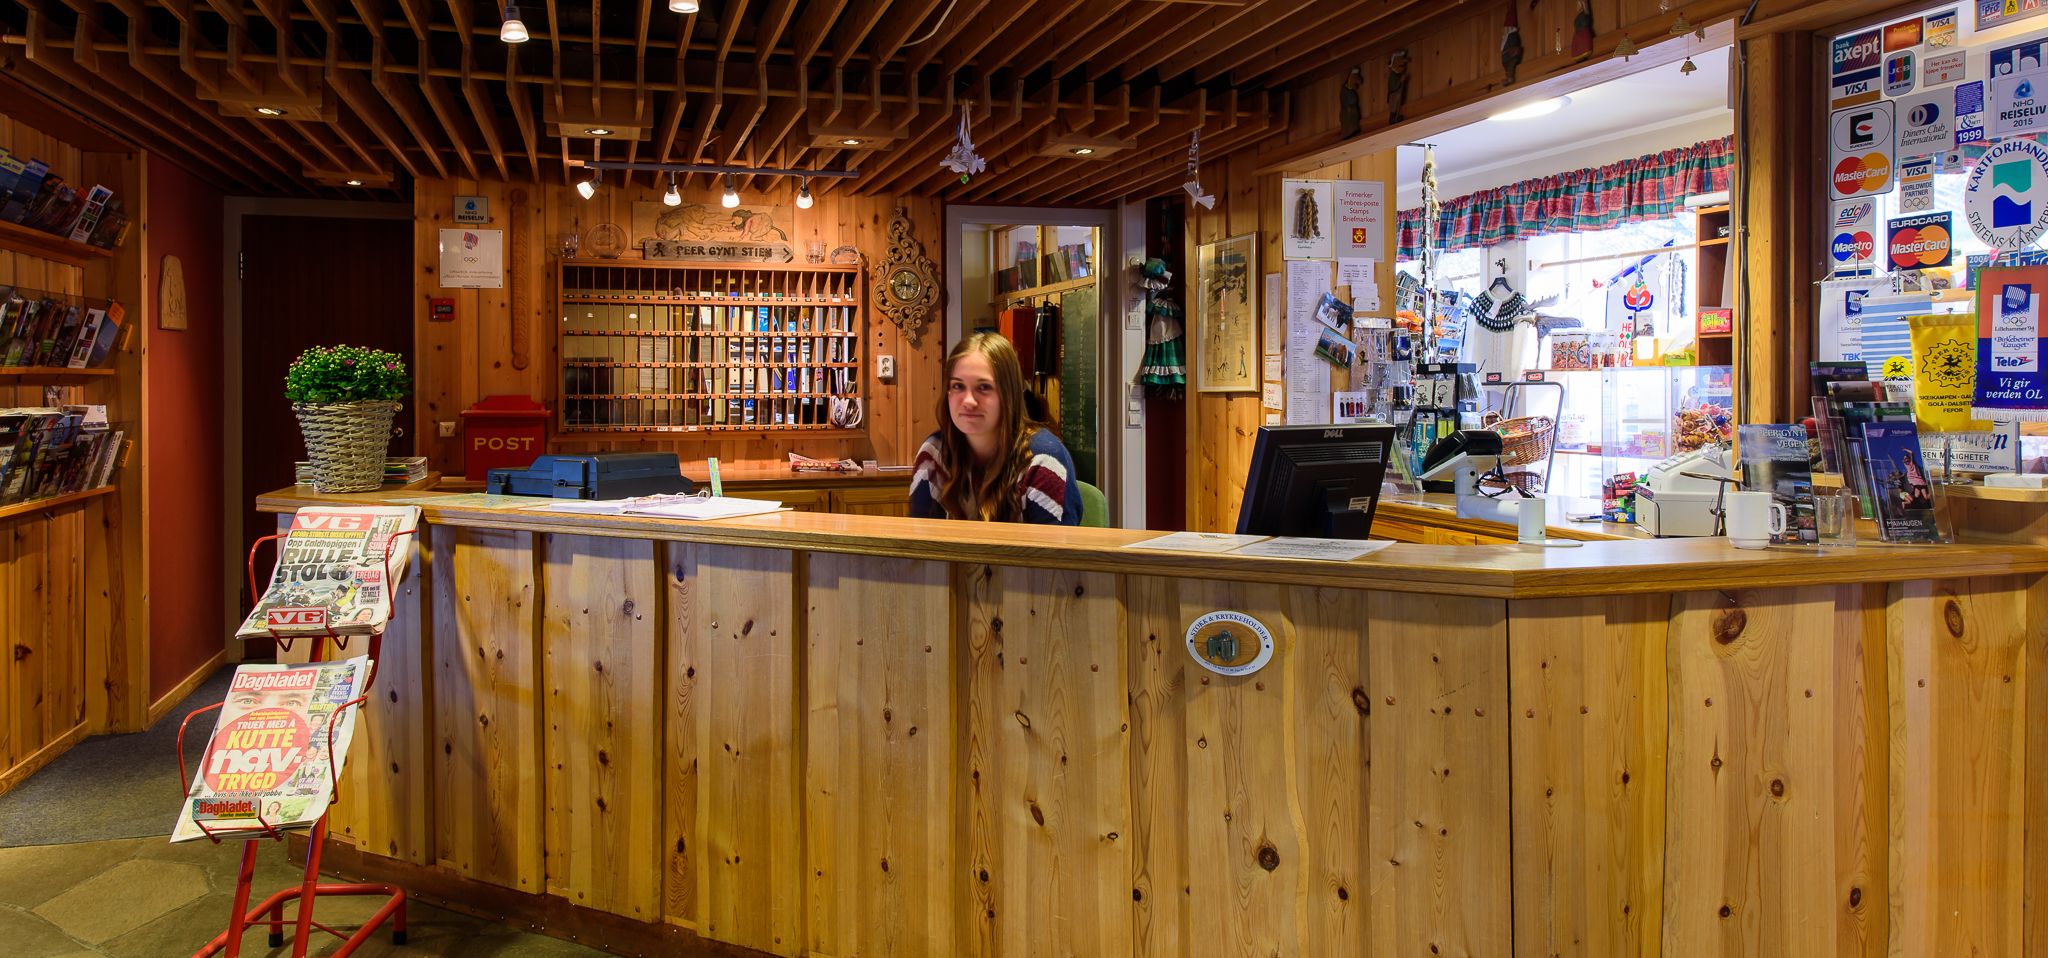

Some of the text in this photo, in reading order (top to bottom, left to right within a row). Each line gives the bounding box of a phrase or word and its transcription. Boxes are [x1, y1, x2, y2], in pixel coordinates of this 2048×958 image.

[1932, 18, 1950, 28] VISA
[1834, 33, 1880, 63] axept
[1835, 40, 1850, 50] bank
[1844, 82, 1868, 95] VISA
[2013, 99, 2034, 108] NHO
[2000, 105, 2047, 120] REISELIV
[2013, 118, 2033, 127] 2015
[1902, 123, 1946, 138] Diners Club
[1957, 130, 1982, 142] 1999
[1900, 132, 1948, 147] International
[1834, 166, 1889, 183] MasterCard
[1906, 166, 1928, 176] VISA
[1901, 182, 1933, 191] WORLDWIDE
[1340, 199, 1379, 207] Timbres-poste
[1890, 215, 1949, 228] EUROCARD
[1969, 211, 2005, 248] STATENS
[676, 246, 773, 257] PEER GYNT STIEN
[1833, 241, 1873, 253] Maestro
[1890, 238, 1949, 255] MasterCard
[1842, 353, 1861, 361] TBK
[1999, 377, 2031, 390] Vi gir
[1986, 389, 2043, 400] verden OL
[1323, 429, 1344, 439] DELL
[1780, 429, 1804, 437] GYNT
[474, 437, 535, 451] POST
[1776, 440, 1807, 448] VEGEN
[297, 515, 362, 530] VG
[287, 539, 303, 547] Opp
[282, 549, 358, 565] RULLE-
[274, 564, 327, 584] STOL
[270, 612, 321, 624] VG
[1190, 618, 1209, 637] STOKK
[1215, 613, 1269, 642] KRYKKEHOLDER
[234, 671, 314, 691] Dagbladet
[237, 721, 267, 730] TRUER
[288, 719, 296, 728] Å
[225, 728, 297, 749] KUTTE
[217, 772, 277, 791] TRYGD
[199, 801, 252, 815] Dagbladet
